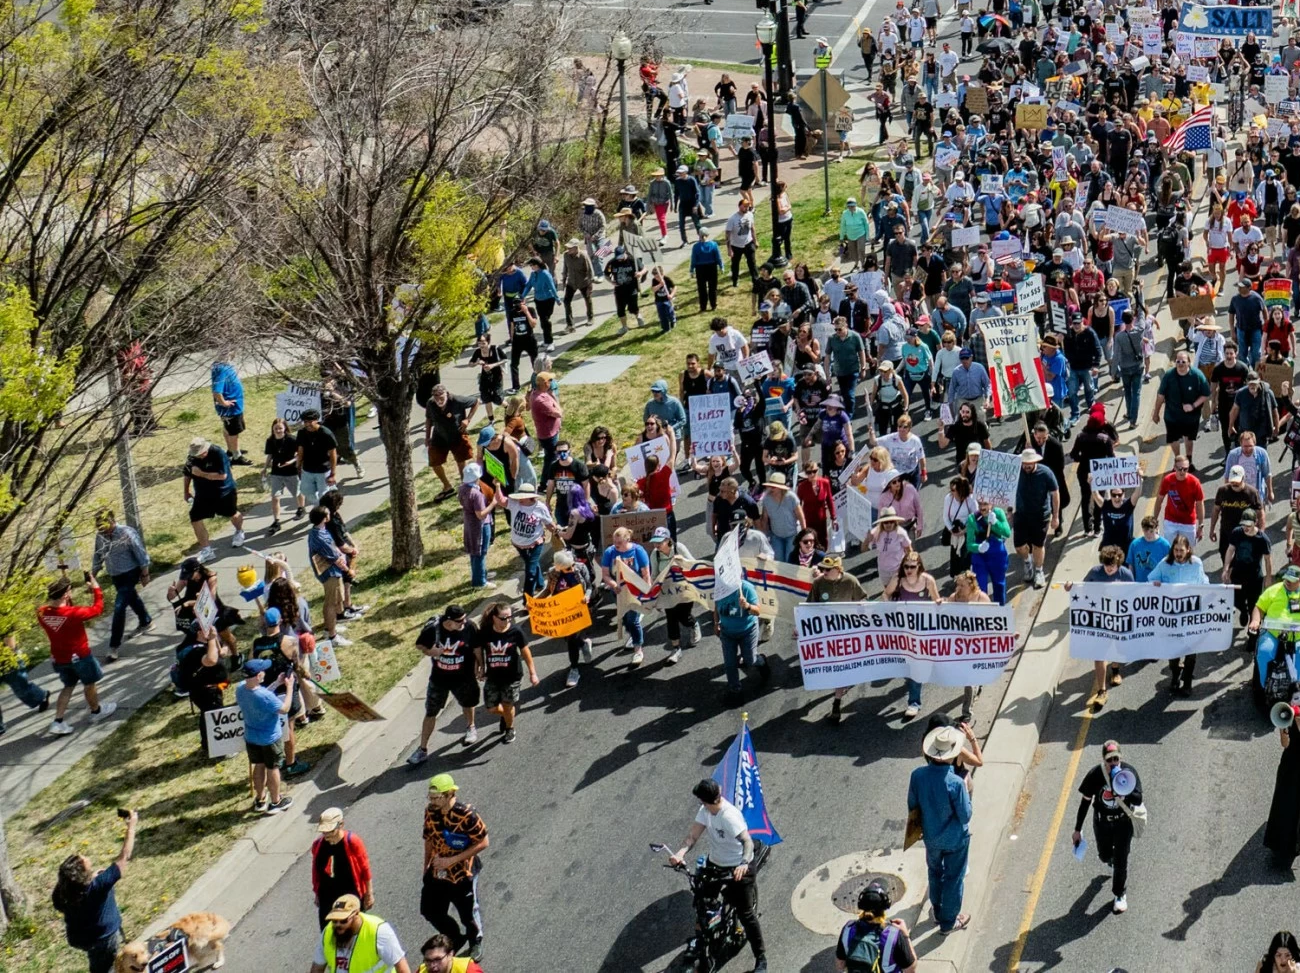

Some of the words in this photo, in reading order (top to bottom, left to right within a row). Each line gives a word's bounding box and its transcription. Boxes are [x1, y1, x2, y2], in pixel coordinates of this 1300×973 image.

[1211, 8, 1268, 29] SALT
[1019, 291, 1030, 301] Tax
[1031, 286, 1041, 296] $$$
[1020, 305, 1029, 313] For
[1030, 298, 1043, 308] War!
[981, 317, 1029, 330] THIRSTY
[715, 343, 726, 352] NO
[988, 335, 1028, 349] JUSTICE
[697, 409, 725, 421] RAPIST
[981, 450, 1018, 464] DENY
[1092, 458, 1119, 472] Donald
[978, 469, 1017, 482] DEFEND
[1095, 475, 1113, 487] Child
[1113, 472, 1141, 486] RAPIST
[515, 510, 526, 522] NO
[611, 518, 620, 528] I
[626, 516, 657, 526] believe
[513, 520, 536, 534] KINGS
[1101, 597, 1112, 612] IT
[1116, 599, 1129, 614] IS
[1133, 597, 1159, 611] OUR
[1163, 595, 1199, 614] DUTY
[532, 611, 583, 627] CONCENTRATION
[801, 616, 822, 637] NO
[826, 613, 871, 632] KINGS
[873, 614, 883, 626] &
[885, 611, 904, 629] NO
[908, 613, 1008, 633] BILLIONAIRES!
[1073, 610, 1090, 626] TO
[1093, 612, 1131, 632] FIGHT
[1136, 616, 1155, 628] FOR
[1158, 617, 1178, 629] OUR
[1181, 613, 1231, 627] FREEDOM!
[1096, 631, 1120, 641] SOCIALISM
[1129, 631, 1155, 640] LIBERATION
[801, 642, 825, 661] WE
[827, 638, 861, 658] NEED
[865, 635, 874, 651] A
[876, 634, 917, 655] WHOLE
[920, 638, 951, 657] NEW
[954, 636, 1014, 655] SYSTEM!
[804, 666, 821, 675] PARTY
[822, 665, 832, 673] FOR
[833, 662, 863, 672] SOCIALISM
[863, 659, 875, 667] AND
[876, 657, 906, 666] LIBERATION
[213, 726, 245, 741] Save
